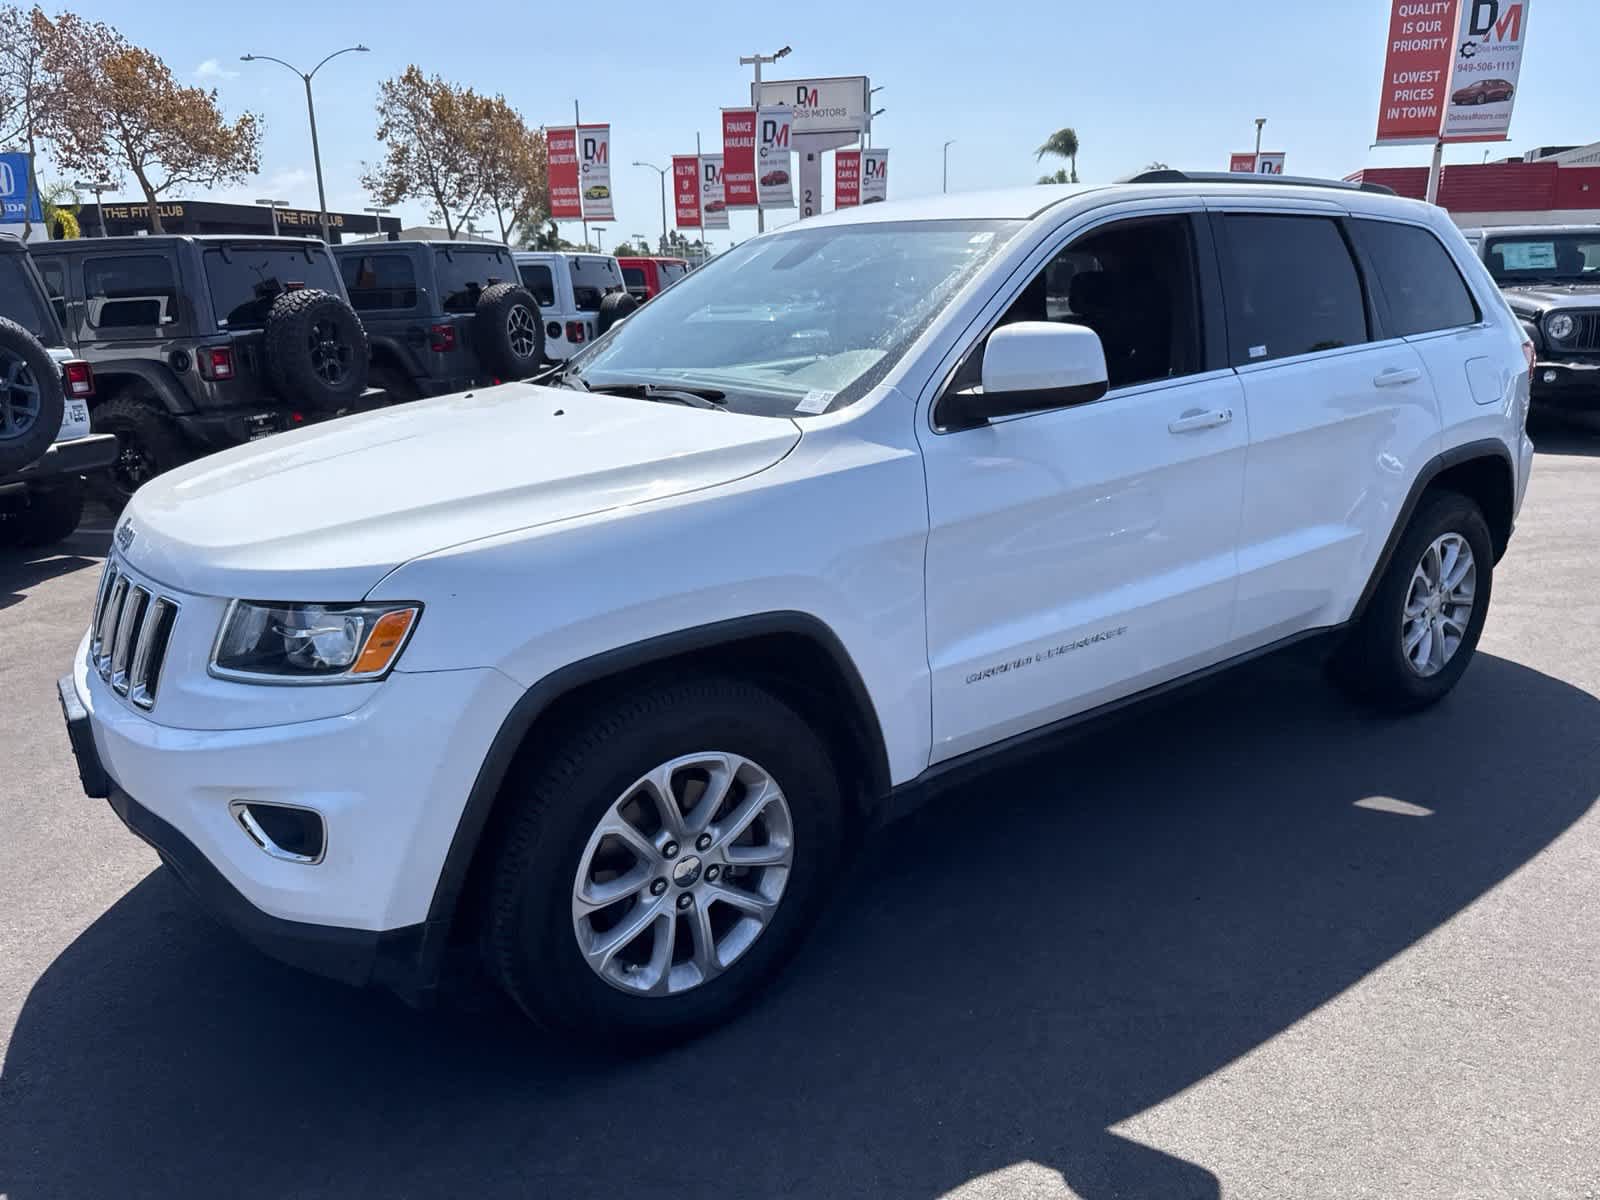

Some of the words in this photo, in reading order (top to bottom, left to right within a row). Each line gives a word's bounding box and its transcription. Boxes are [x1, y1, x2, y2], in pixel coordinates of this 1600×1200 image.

[1398, 3, 1450, 17] QUALITY
[1402, 22, 1413, 35] IS
[1416, 21, 1442, 33] OUR
[1393, 39, 1447, 52] PRIORITY
[1392, 70, 1441, 84] LOWEST
[1394, 88, 1435, 102] PRICES
[811, 108, 848, 118] MOTORS
[1386, 107, 1401, 119] IN
[1403, 106, 1437, 118] TOWN
[726, 122, 752, 133] FINANCE
[103, 207, 129, 218] THE
[131, 206, 149, 217] FIT
[275, 211, 298, 224] THE
[301, 213, 317, 225] FIT
